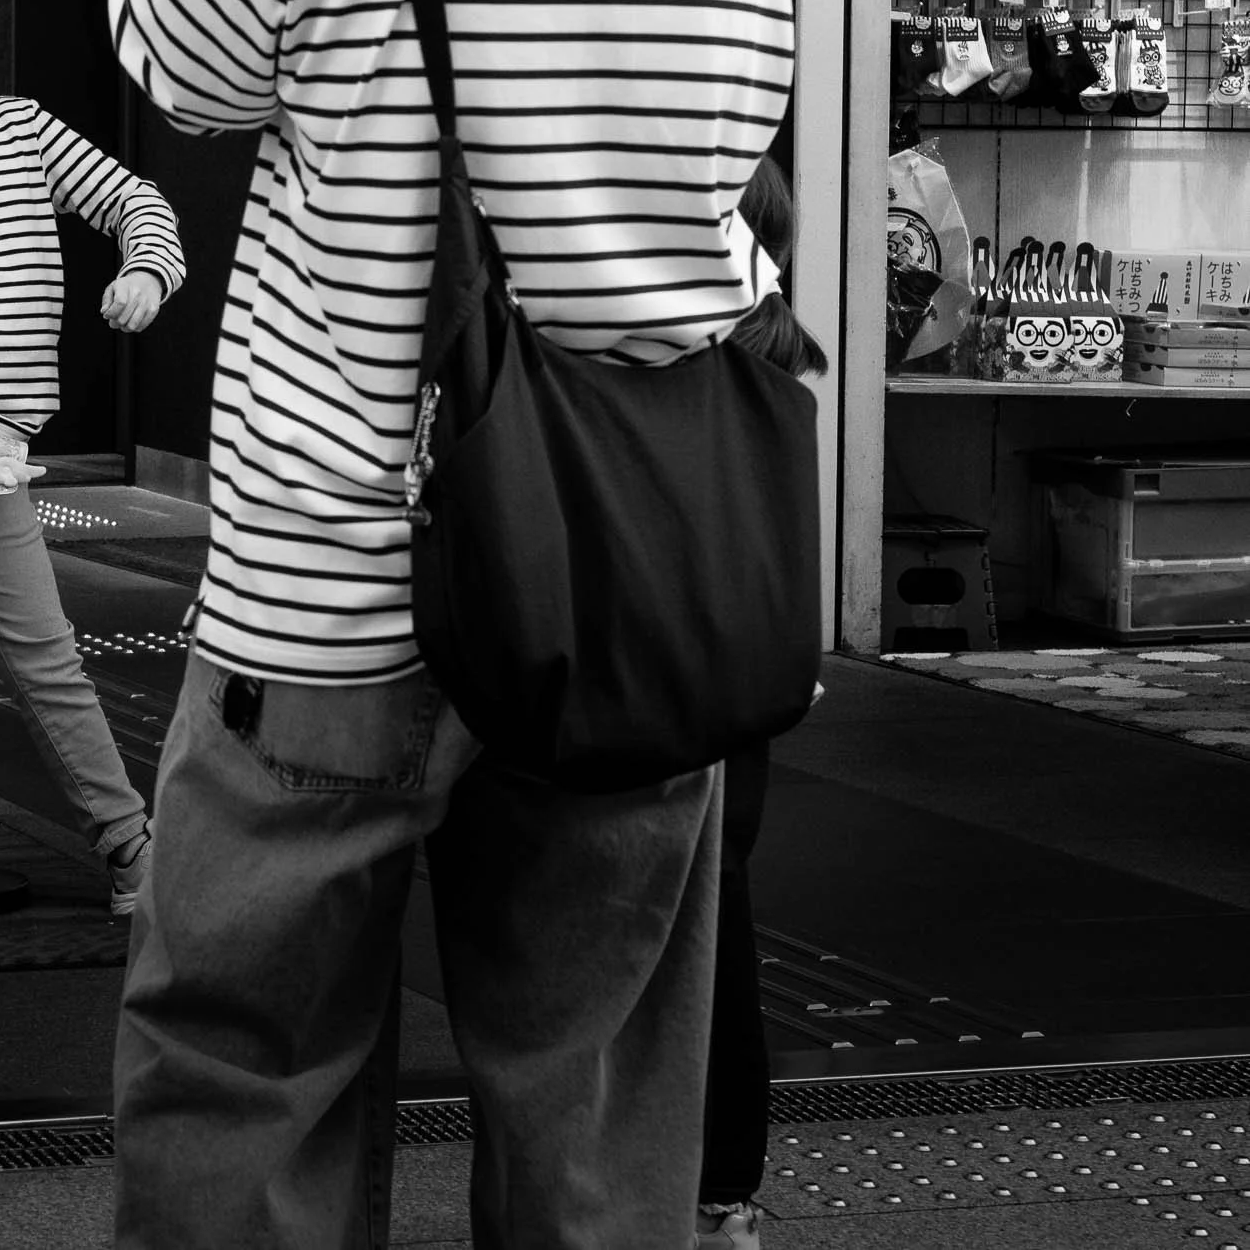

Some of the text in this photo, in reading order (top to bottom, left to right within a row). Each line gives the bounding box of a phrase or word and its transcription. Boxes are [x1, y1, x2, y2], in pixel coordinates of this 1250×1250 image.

[1115, 259, 1129, 301] ケーキ
[1128, 259, 1143, 313] はちみつ
[1206, 261, 1220, 303] ケーキ
